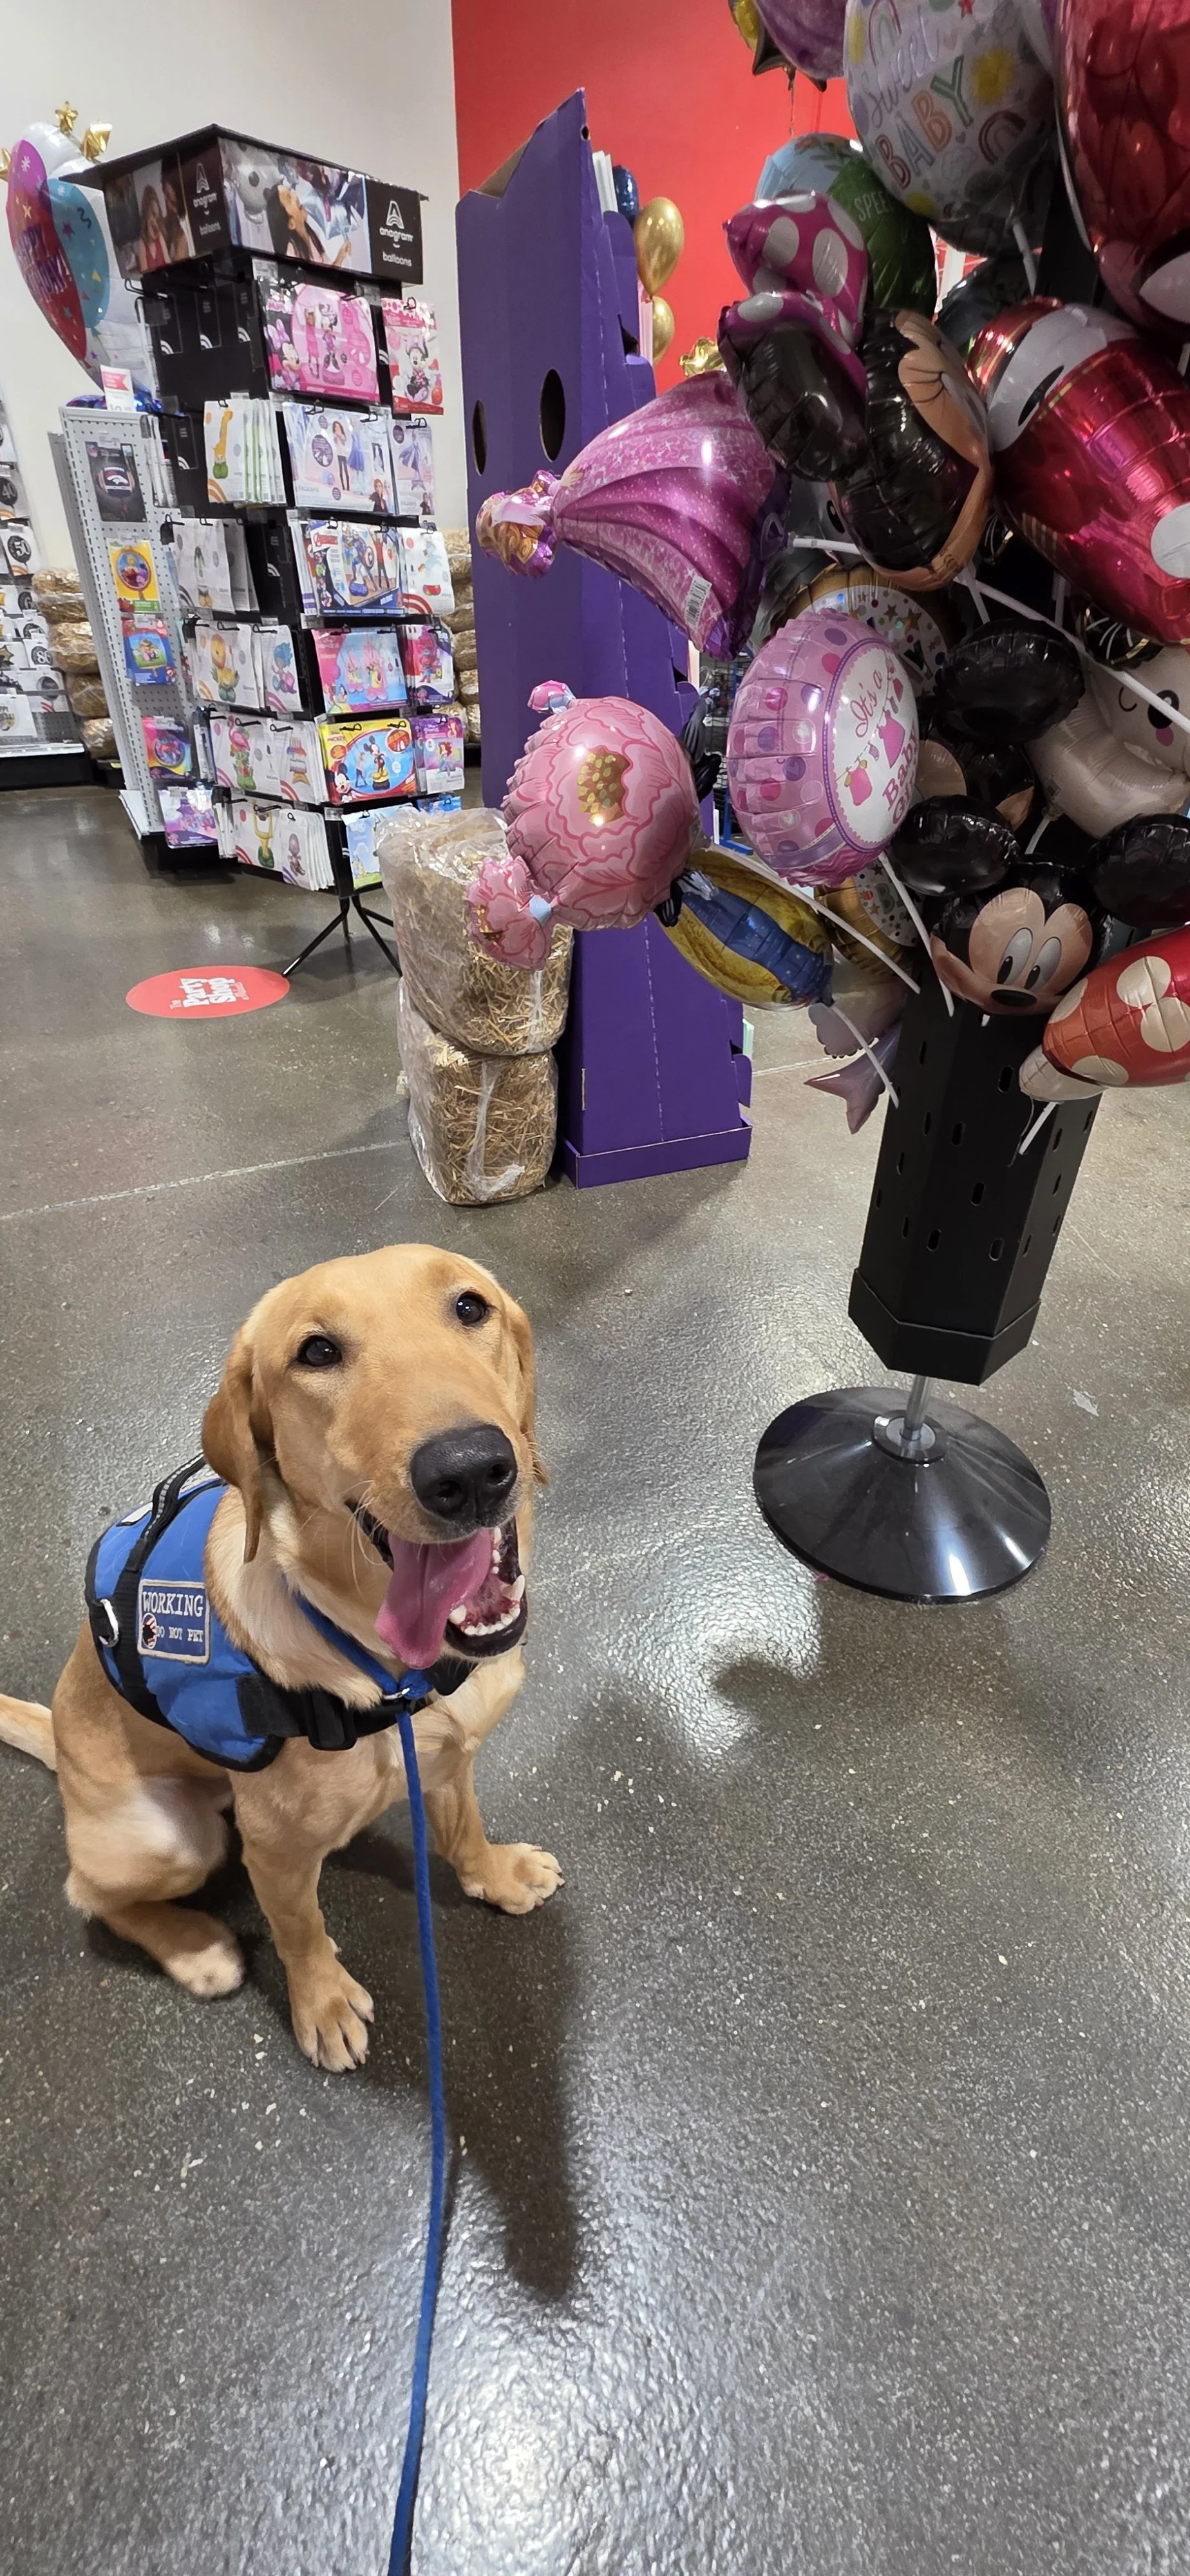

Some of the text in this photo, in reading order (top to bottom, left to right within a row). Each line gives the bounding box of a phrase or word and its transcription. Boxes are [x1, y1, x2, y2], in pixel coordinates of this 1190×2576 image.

[875, 53, 974, 189] BABY
[379, 227, 413, 242] anagram
[382, 251, 412, 267] balloons
[2, 482, 16, 499] 40
[14, 540, 30, 556] 50
[850, 669, 883, 738] It's a
[882, 720, 917, 812] Baby
[179, 978, 210, 1008] Party
[207, 977, 237, 1004] Shop
[142, 1591, 203, 1616] WORKING
[156, 1625, 165, 1638] DO
[169, 1626, 183, 1640] NOT
